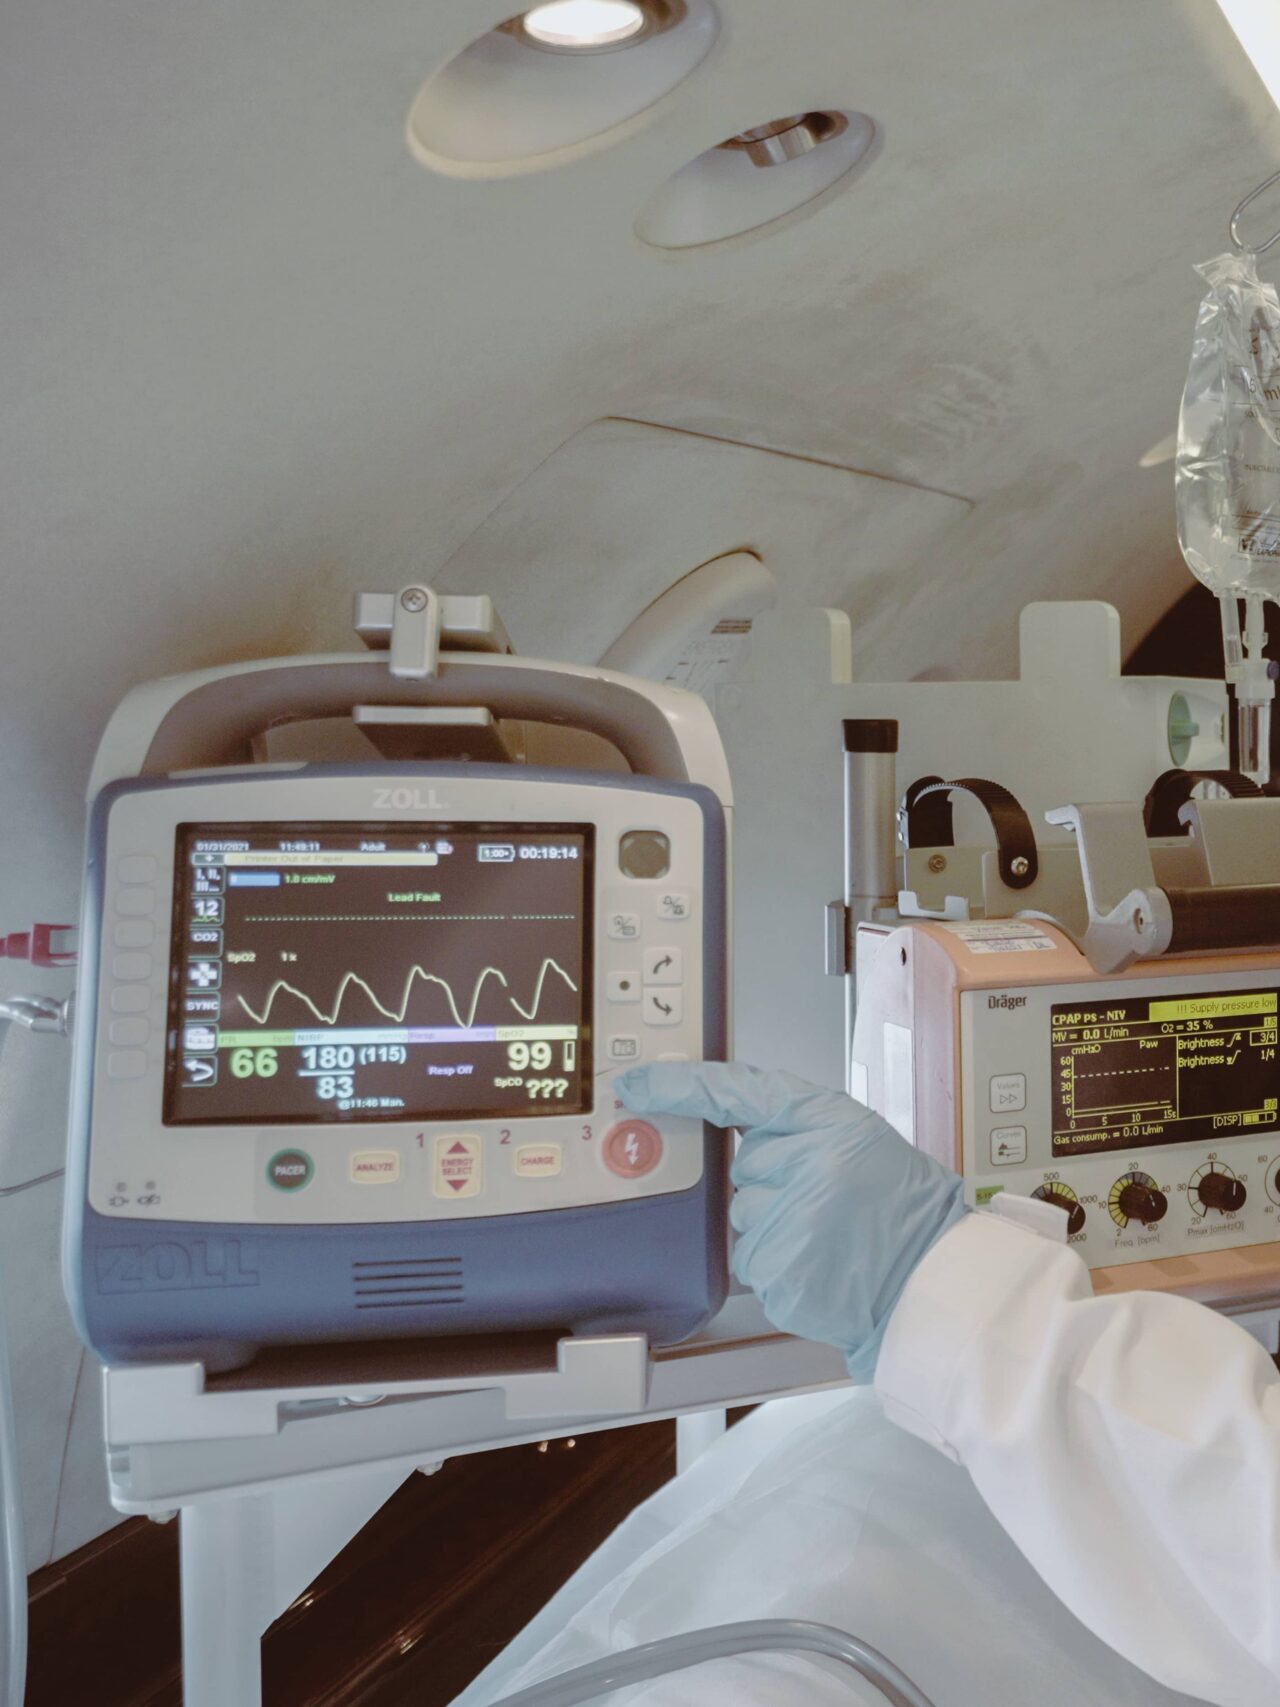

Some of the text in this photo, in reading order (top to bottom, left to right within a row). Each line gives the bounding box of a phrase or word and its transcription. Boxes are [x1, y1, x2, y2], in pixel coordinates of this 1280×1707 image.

[372, 789, 443, 810] ZOLL
[195, 841, 250, 852] 01/31/2021
[359, 841, 386, 852] Adult
[518, 845, 579, 860] 00:19:14
[280, 854, 299, 863] Out
[301, 854, 311, 863] of
[314, 855, 345, 864] Paper
[285, 874, 336, 885] 1.0 cm/mV
[387, 892, 442, 902] Lead Fault
[194, 901, 219, 917] 12
[191, 932, 219, 943] CO2
[226, 952, 257, 964] SpO2
[185, 1000, 220, 1011] SYNC
[987, 994, 1028, 1011] Dräger
[1190, 1002, 1219, 1016] Supply
[1220, 1000, 1259, 1014] pressure
[1260, 997, 1277, 1009] low
[1052, 1012, 1083, 1026] CPAP
[1084, 1013, 1098, 1025] ps
[1106, 1009, 1127, 1022] NIV
[1186, 1021, 1200, 1032] 35
[1202, 1019, 1214, 1031] %
[1052, 1031, 1067, 1042] MV
[1082, 1029, 1101, 1041] 0.0
[1103, 1027, 1129, 1040] L/min
[1260, 1031, 1276, 1044] 3/4
[1139, 1039, 1159, 1050] Paw
[1177, 1037, 1225, 1051] Brightness
[303, 1046, 407, 1070] 180 (115)
[507, 1041, 552, 1072] 99
[1260, 1048, 1275, 1061] 1/4
[230, 1048, 279, 1079] 66
[1060, 1056, 1072, 1067] 60
[1177, 1055, 1225, 1068] Brightness
[426, 1064, 475, 1077] Resp Off
[1060, 1069, 1072, 1080] 45
[316, 1075, 355, 1100] 83
[493, 1077, 569, 1099] SpCO ???
[996, 1081, 1021, 1090] Values
[1060, 1082, 1072, 1093] 30
[1061, 1094, 1072, 1105] 15
[1065, 1107, 1072, 1117] 0
[1069, 1109, 1177, 1130] 0 5 10 15s
[1212, 1114, 1242, 1129] [DISP]
[500, 1129, 512, 1145] 2
[581, 1125, 593, 1141] 3
[1053, 1134, 1071, 1145] Gas
[1072, 1131, 1111, 1145] consump.
[1123, 1126, 1139, 1138] 0.0
[1141, 1125, 1164, 1137] L/min
[416, 1133, 426, 1148] 1
[520, 1155, 556, 1167] CHARGE
[1207, 1152, 1218, 1161] 40
[355, 1161, 394, 1173] ANALYZE
[440, 1158, 474, 1168] ENERGY
[1128, 1162, 1139, 1171] 20
[274, 1163, 306, 1177] PACER
[441, 1166, 473, 1177] SELECT
[1043, 1171, 1060, 1181] 500
[1161, 1185, 1171, 1194] 40
[1176, 1182, 1187, 1192] 30
[1079, 1194, 1099, 1204] 1000
[1098, 1201, 1107, 1209] 10
[1263, 1206, 1274, 1214] 40
[1191, 1216, 1202, 1226] 20
[1116, 1228, 1122, 1237] 2
[1187, 1226, 1209, 1237] Pmax
[96, 1239, 260, 1295] ZOLL
